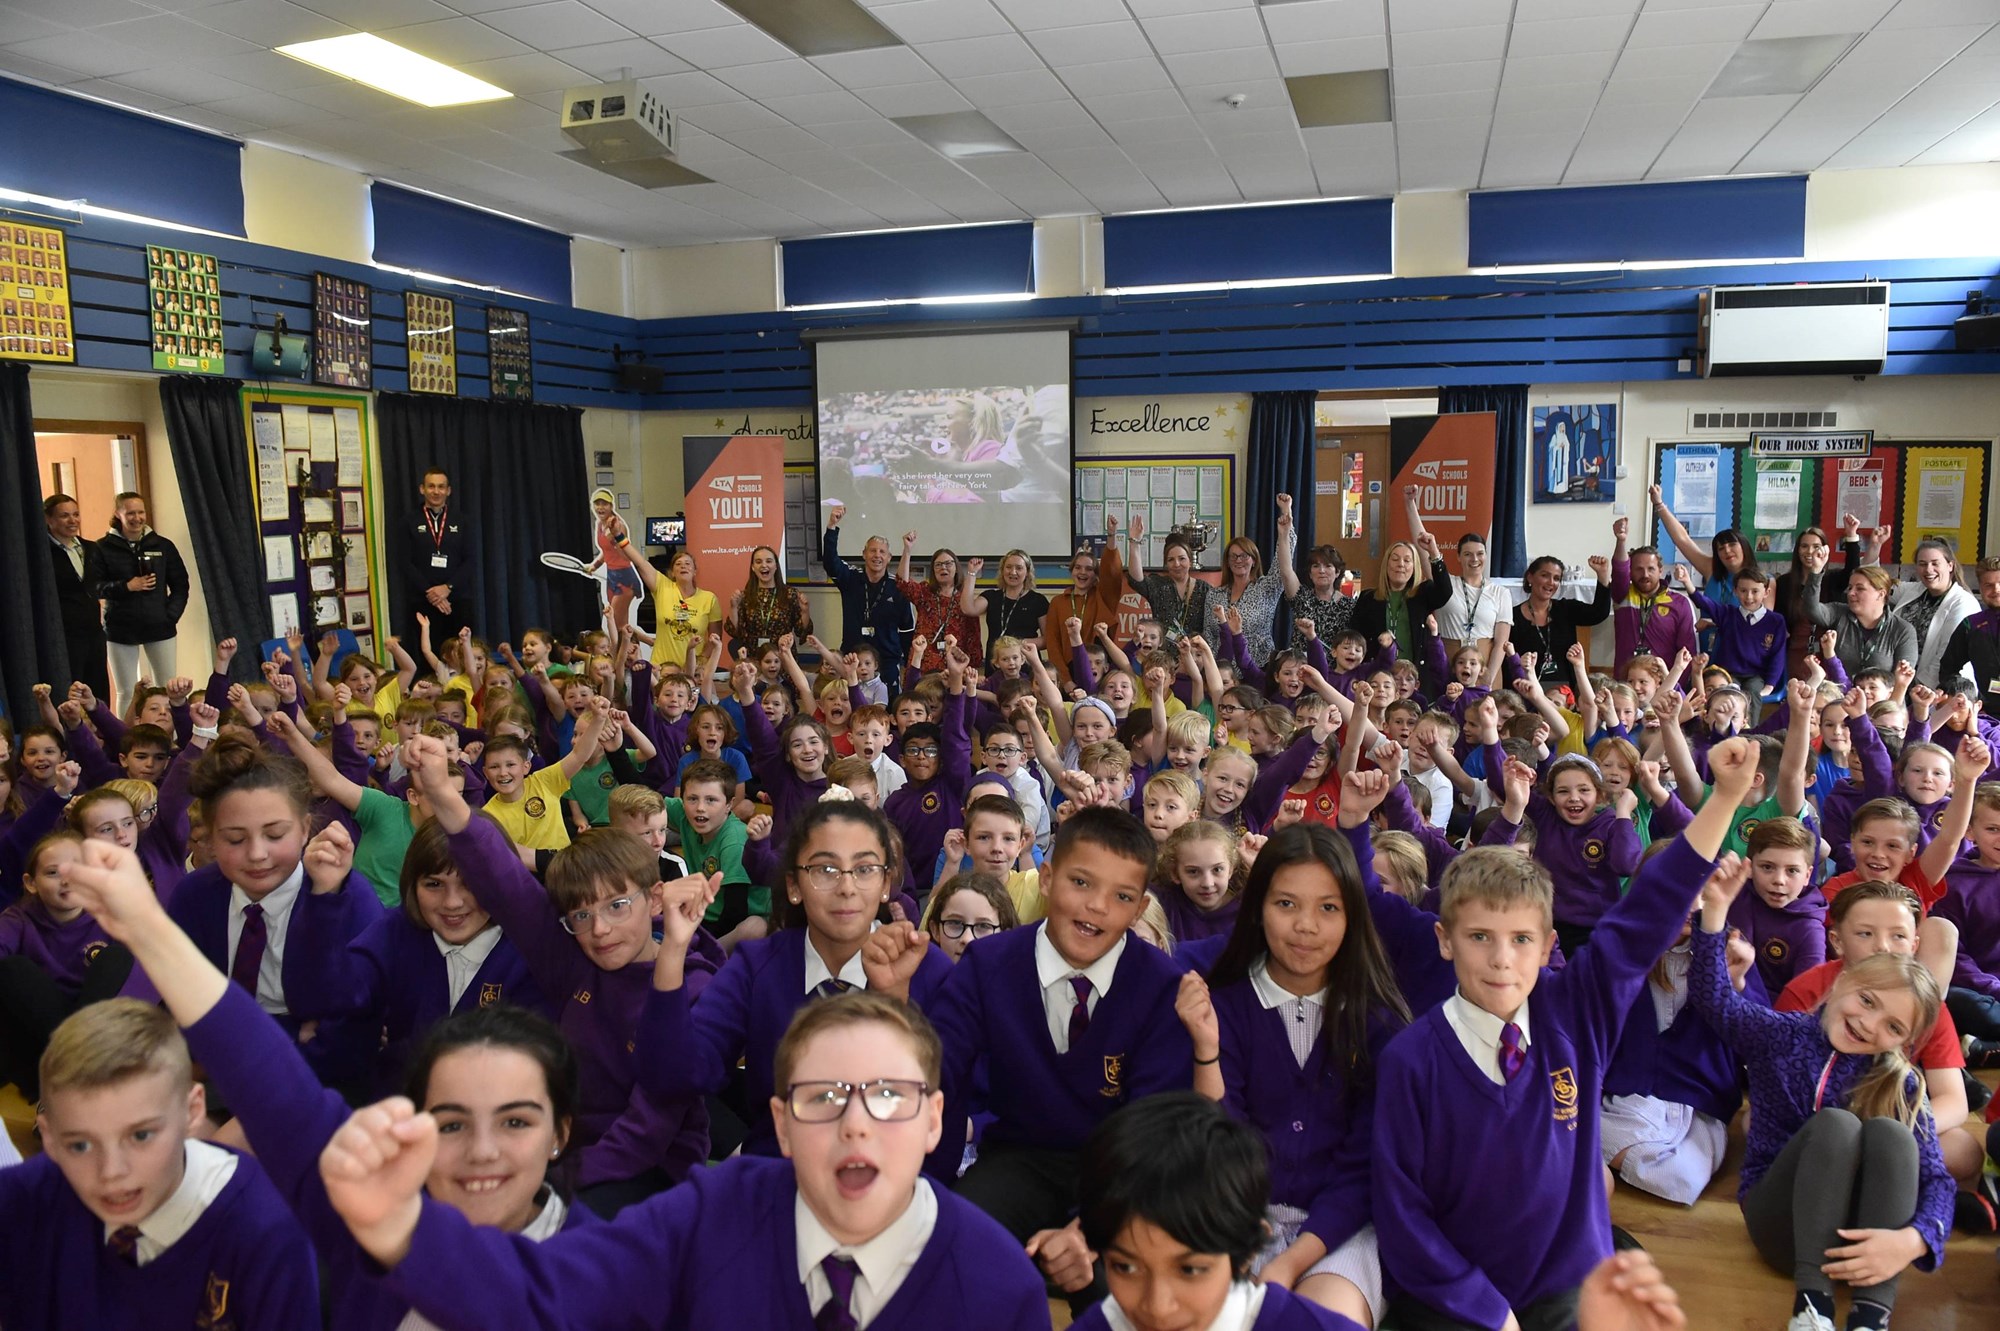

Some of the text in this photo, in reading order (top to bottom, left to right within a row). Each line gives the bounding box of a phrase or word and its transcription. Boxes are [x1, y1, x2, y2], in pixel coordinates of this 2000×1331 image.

[1090, 403, 1210, 435] Excellence
[1759, 438, 1864, 451] OUR HOUSE SYSTEM
[902, 472, 918, 480] she
[1420, 466, 1468, 480] LTA SCHOOLS
[715, 480, 762, 492] LTA SCHOOLS
[899, 483, 918, 491] fairy
[968, 481, 988, 489] York
[1768, 477, 1790, 488] HILDA
[1849, 475, 1869, 487] BEDE
[1413, 485, 1468, 511] YOUTH
[709, 496, 763, 520] YOUTH
[1124, 596, 1140, 608] LTA
